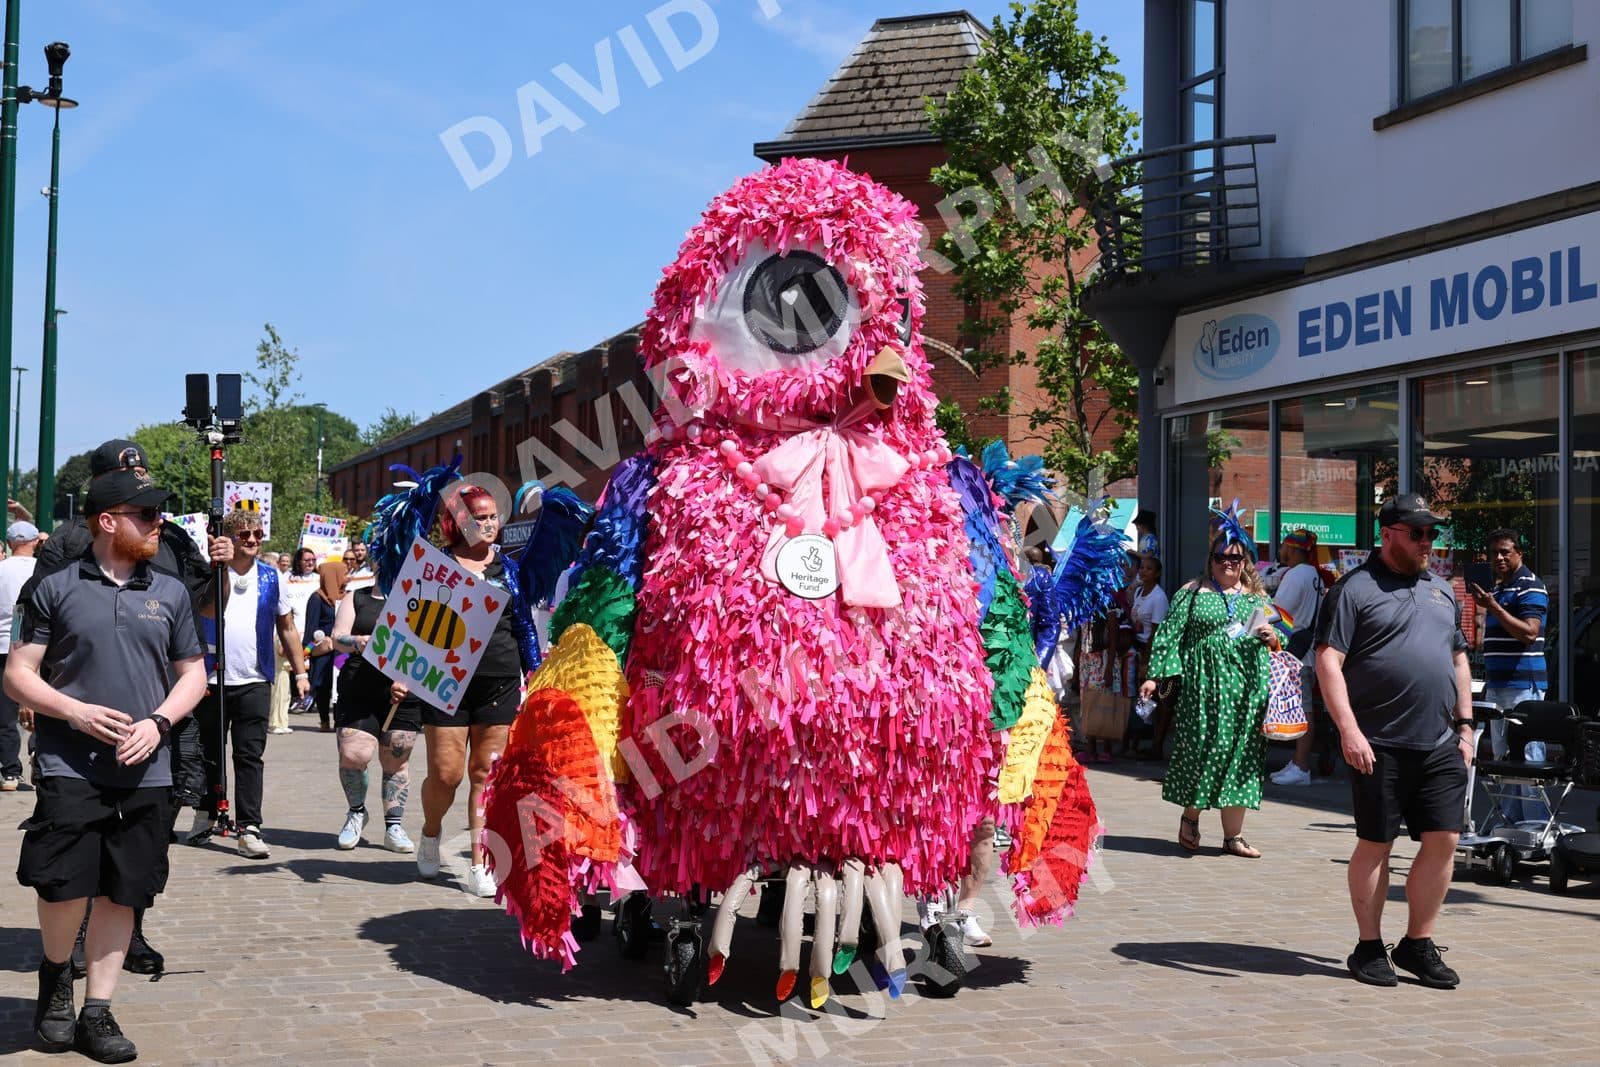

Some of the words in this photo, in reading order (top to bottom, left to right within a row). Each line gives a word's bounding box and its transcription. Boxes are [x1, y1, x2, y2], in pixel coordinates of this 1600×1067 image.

[1299, 286, 1411, 357] EDEN
[1430, 246, 1598, 330] MOBIL
[1219, 326, 1269, 355] Eden
[310, 524, 337, 537] LOUD
[1281, 522, 1307, 532] reen
[1308, 524, 1330, 532] room
[422, 562, 463, 590] BEE
[790, 572, 830, 585] Heritage
[798, 582, 820, 592] Fund
[372, 624, 459, 703] STRONG
